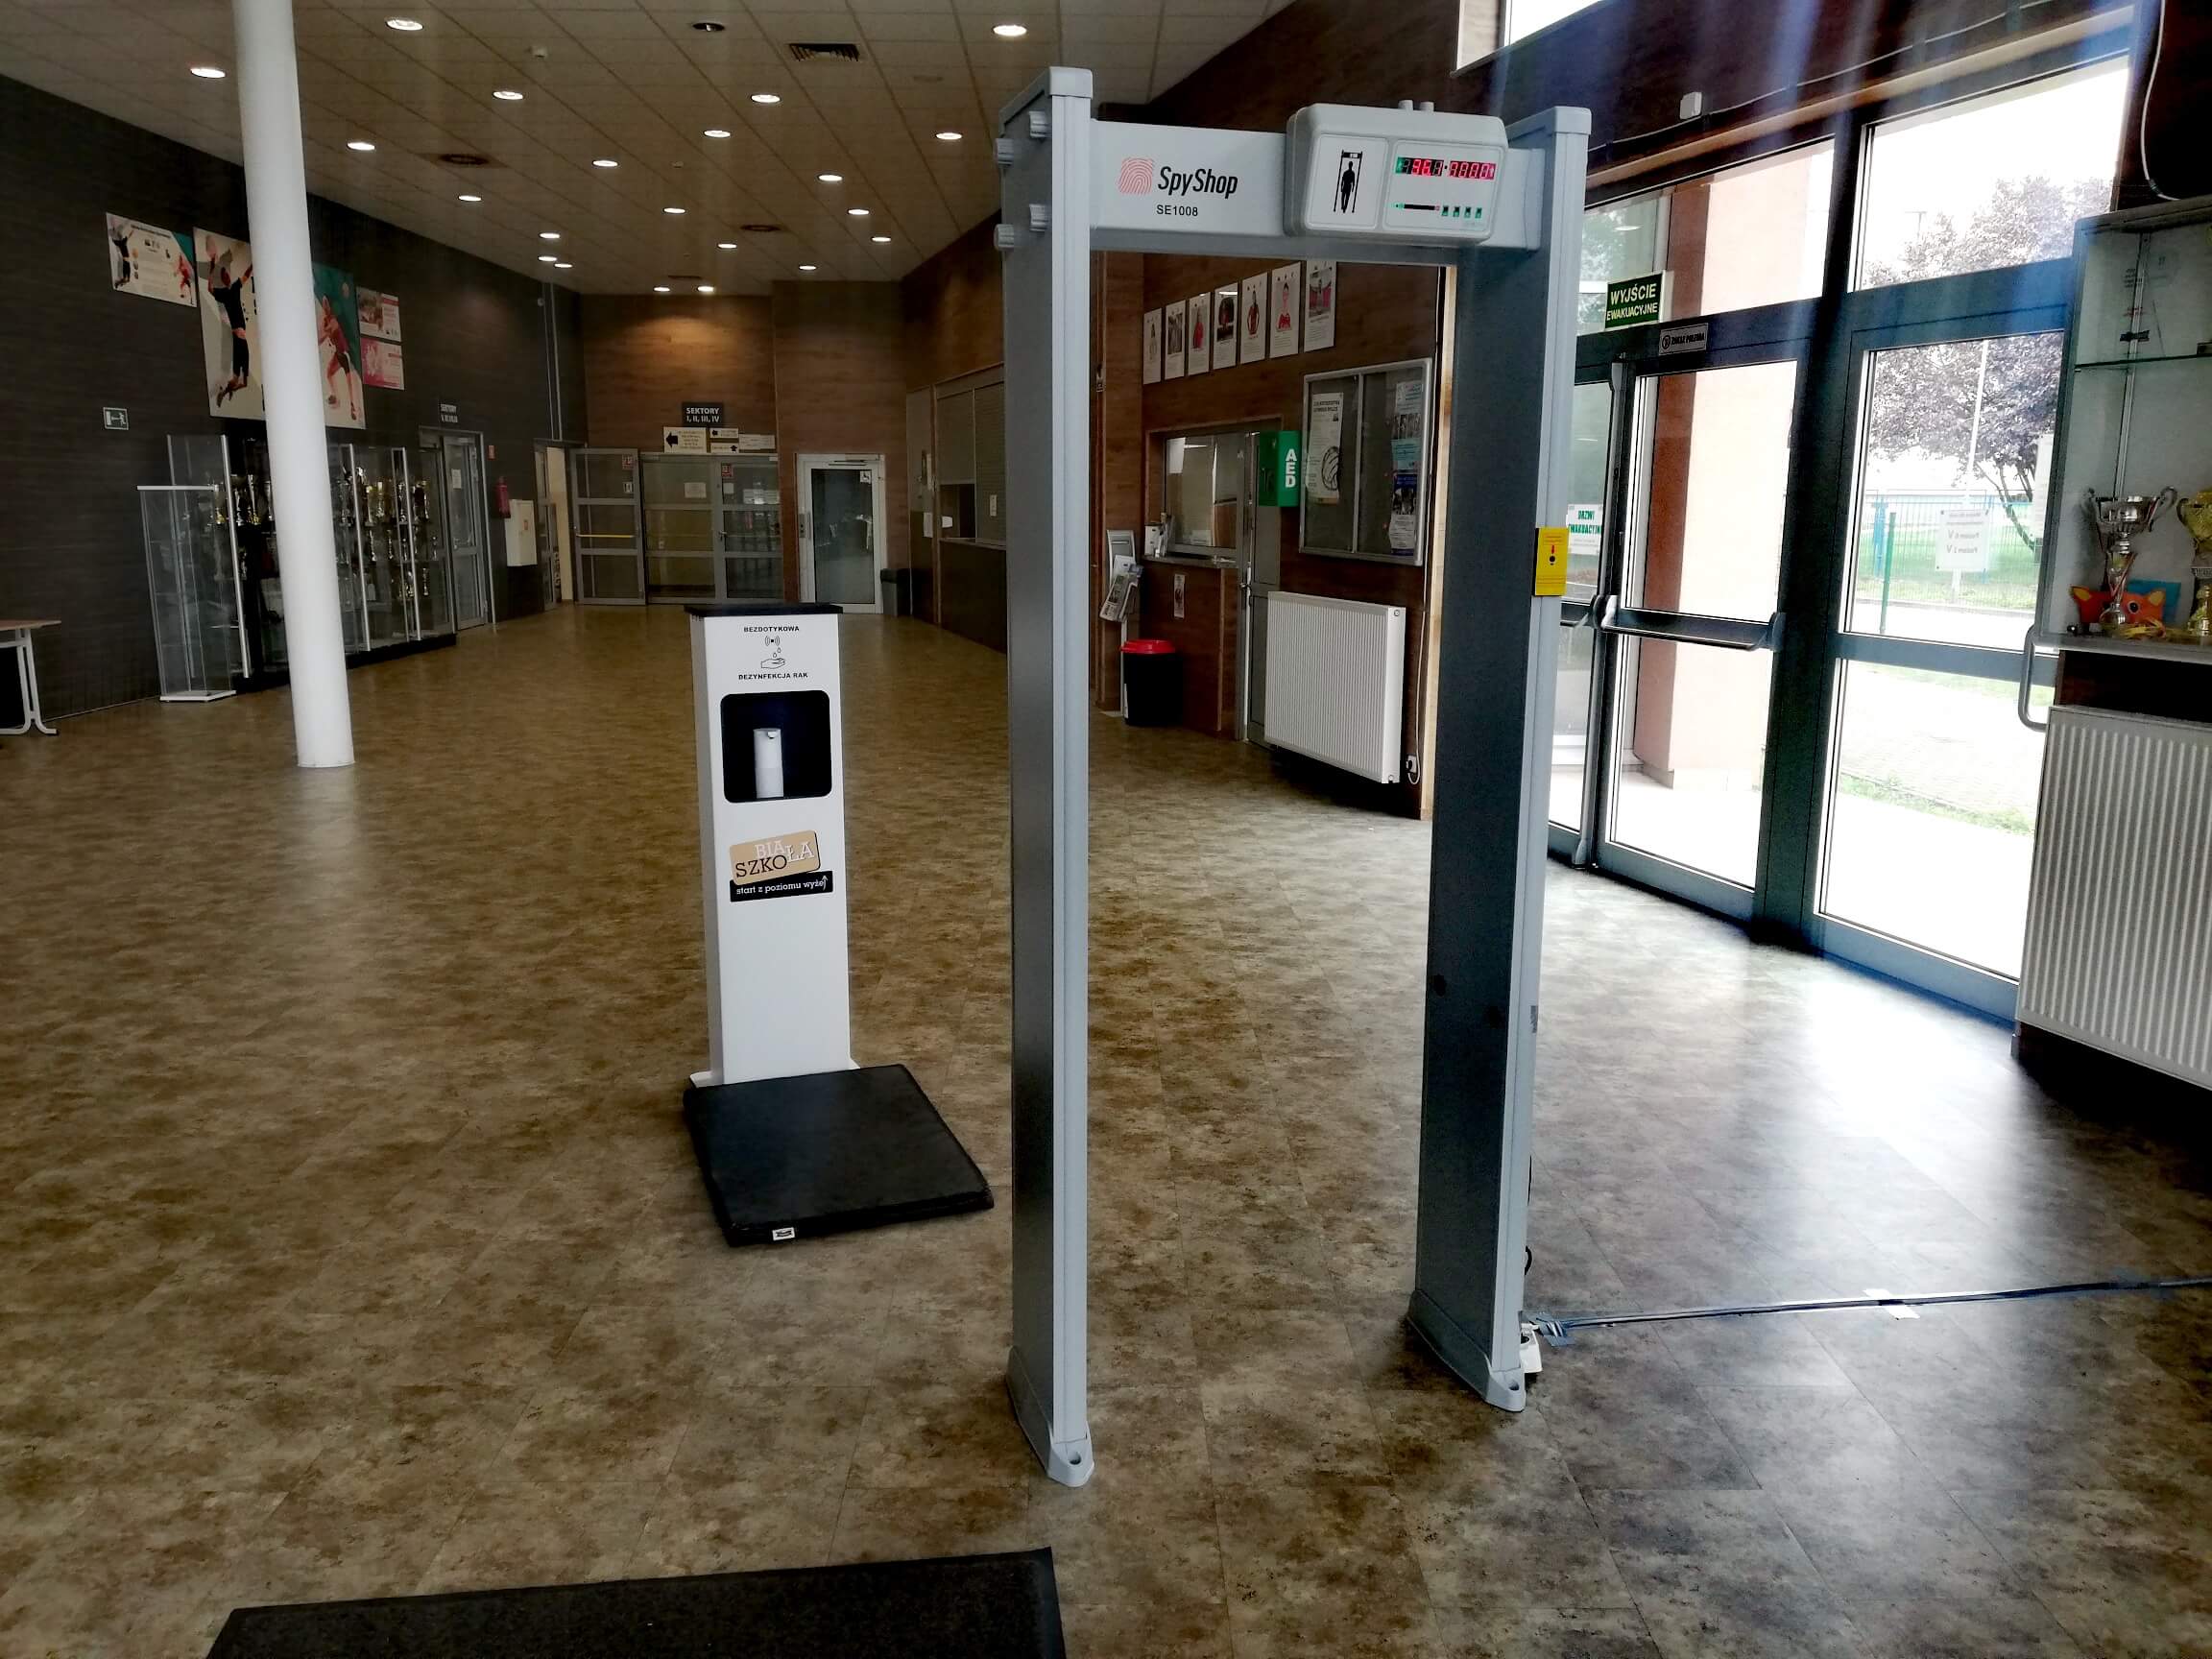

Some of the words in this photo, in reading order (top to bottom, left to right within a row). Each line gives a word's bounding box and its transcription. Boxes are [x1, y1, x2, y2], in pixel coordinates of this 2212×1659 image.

[1157, 166, 1238, 199] SpyShop
[1156, 204, 1198, 216] SE1008
[1610, 283, 1657, 305] WYJŚCIE
[1606, 302, 1659, 321] EWAKUACYJNE
[1285, 447, 1298, 488] AED
[736, 886, 756, 895] start
[764, 882, 802, 895] poziomu
